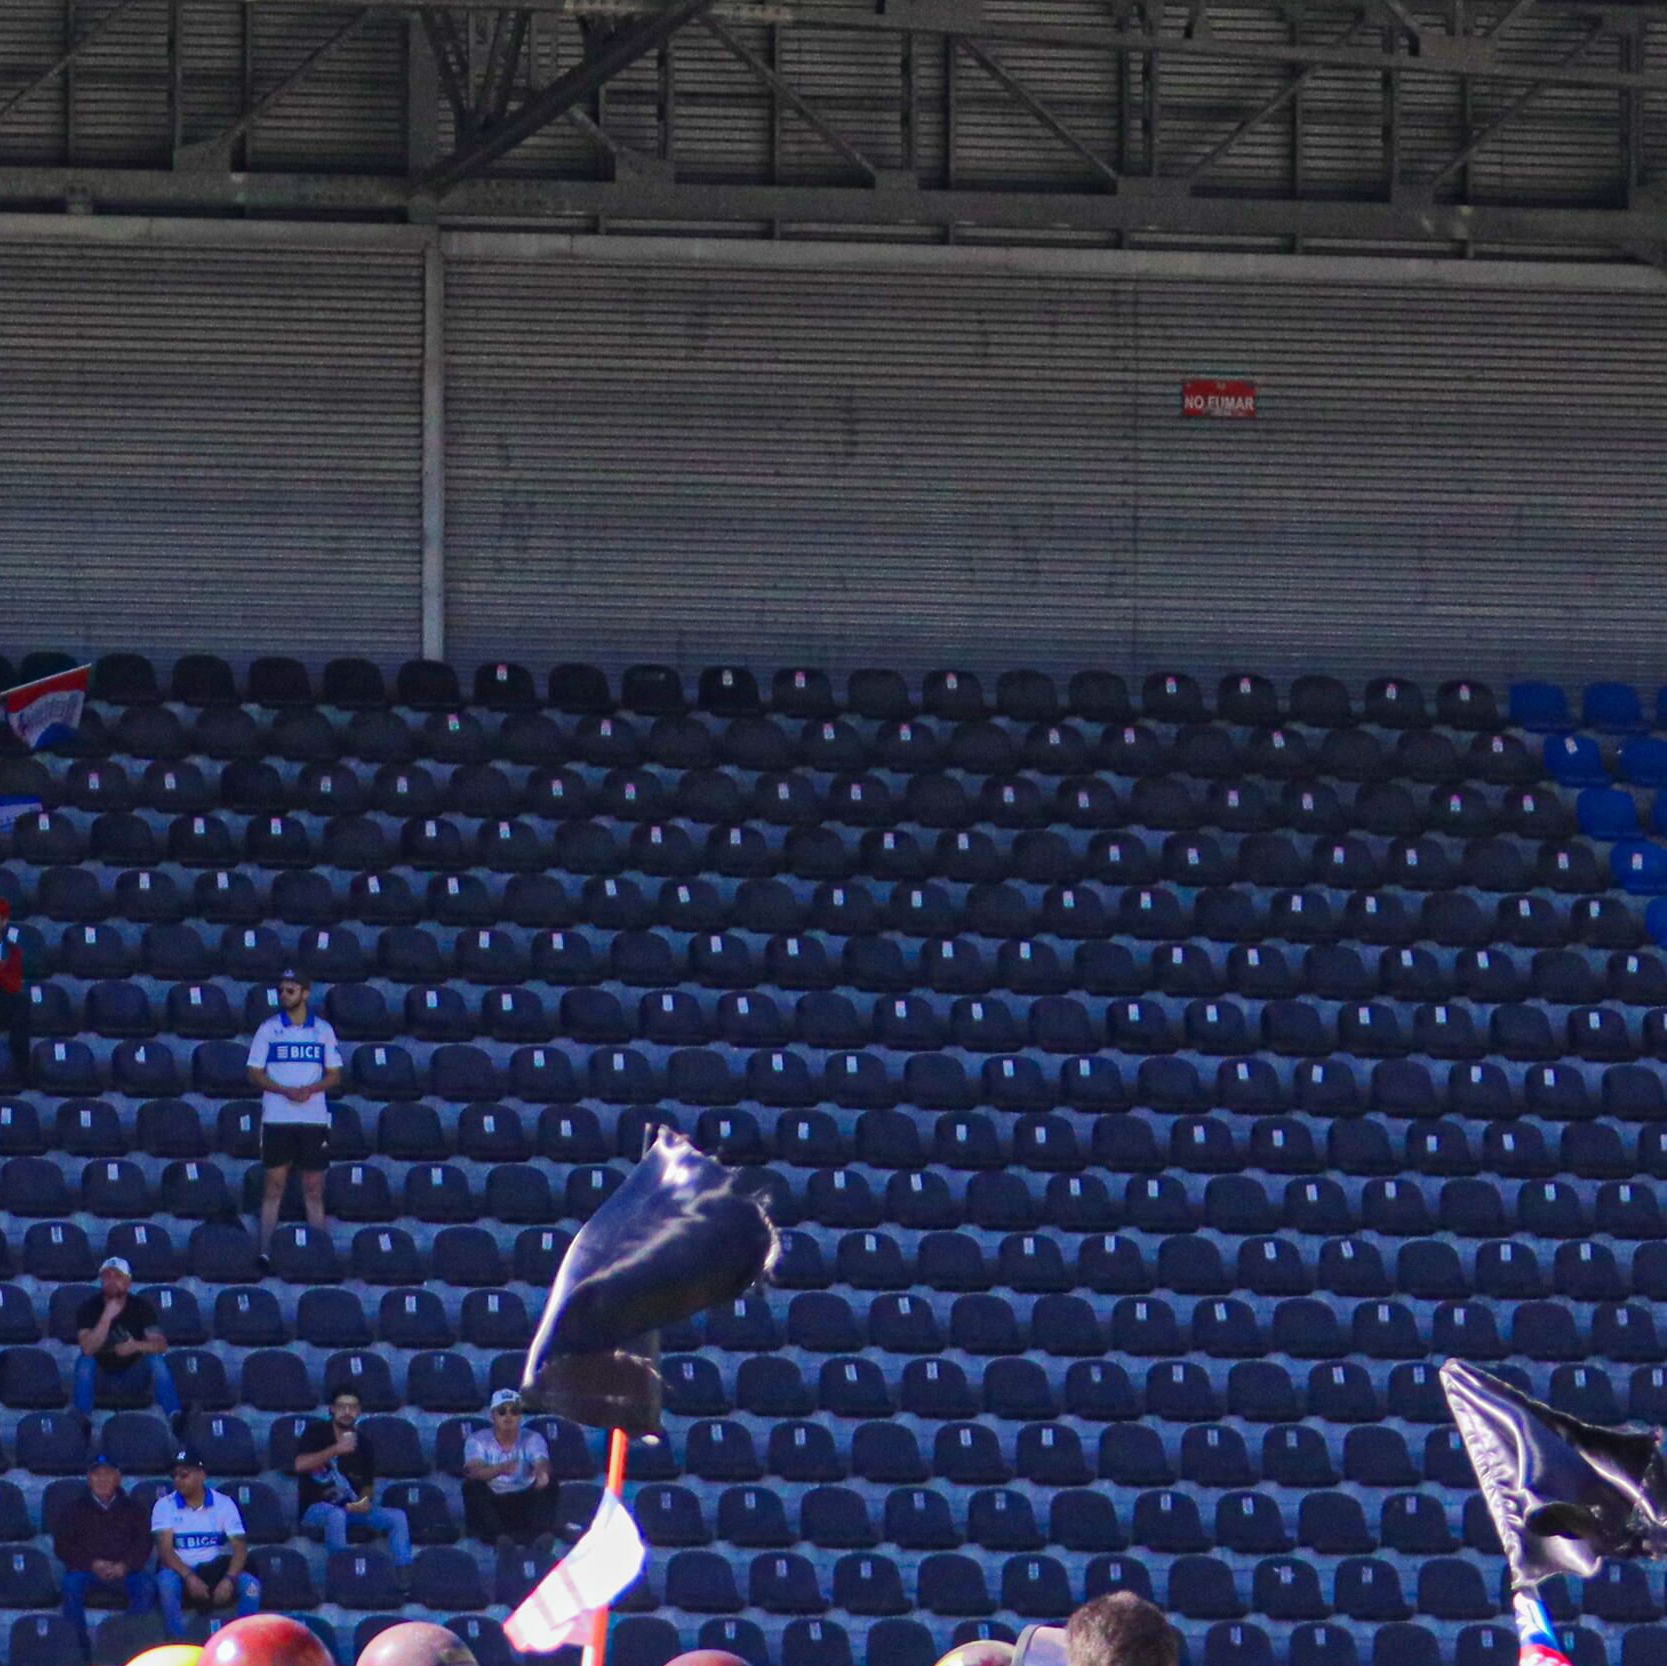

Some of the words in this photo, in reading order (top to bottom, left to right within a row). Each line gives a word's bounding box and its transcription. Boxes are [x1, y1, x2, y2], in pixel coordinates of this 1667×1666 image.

[1183, 395, 1202, 410] NO
[1207, 395, 1254, 410] FUMAR
[290, 1045, 321, 1059] BICE
[186, 1533, 219, 1548] BICE
